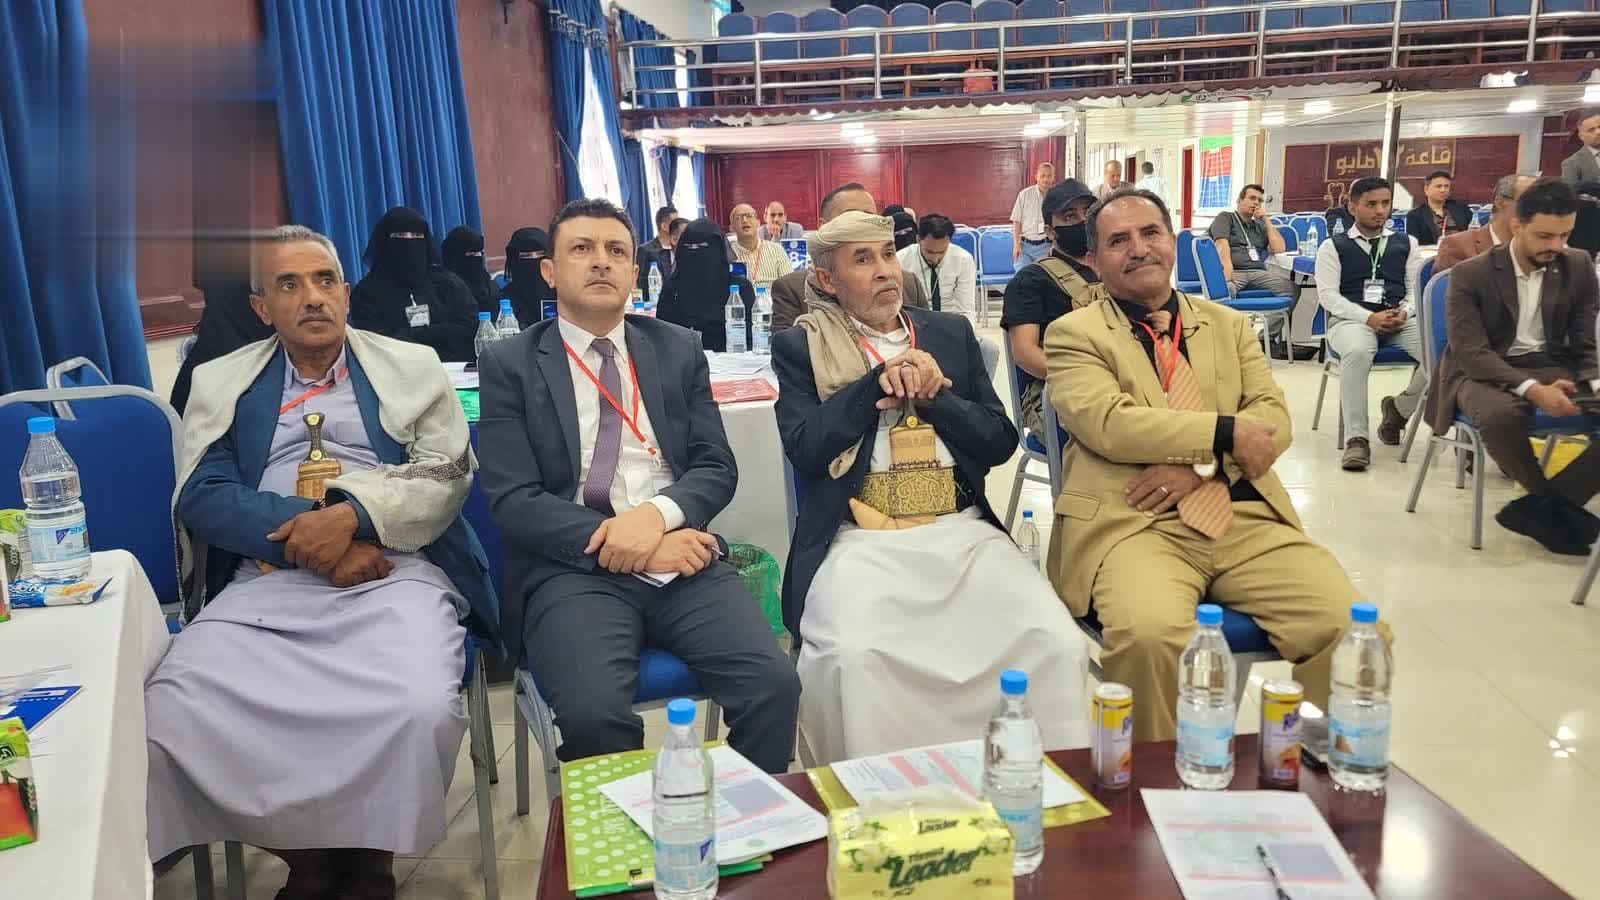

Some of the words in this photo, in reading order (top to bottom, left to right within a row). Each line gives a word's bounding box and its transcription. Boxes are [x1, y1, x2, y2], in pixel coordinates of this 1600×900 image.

[1336, 147, 1375, 176] مايو
[1407, 144, 1451, 165] قاعة
[918, 820, 958, 834] Leader
[885, 849, 979, 889] Leader
